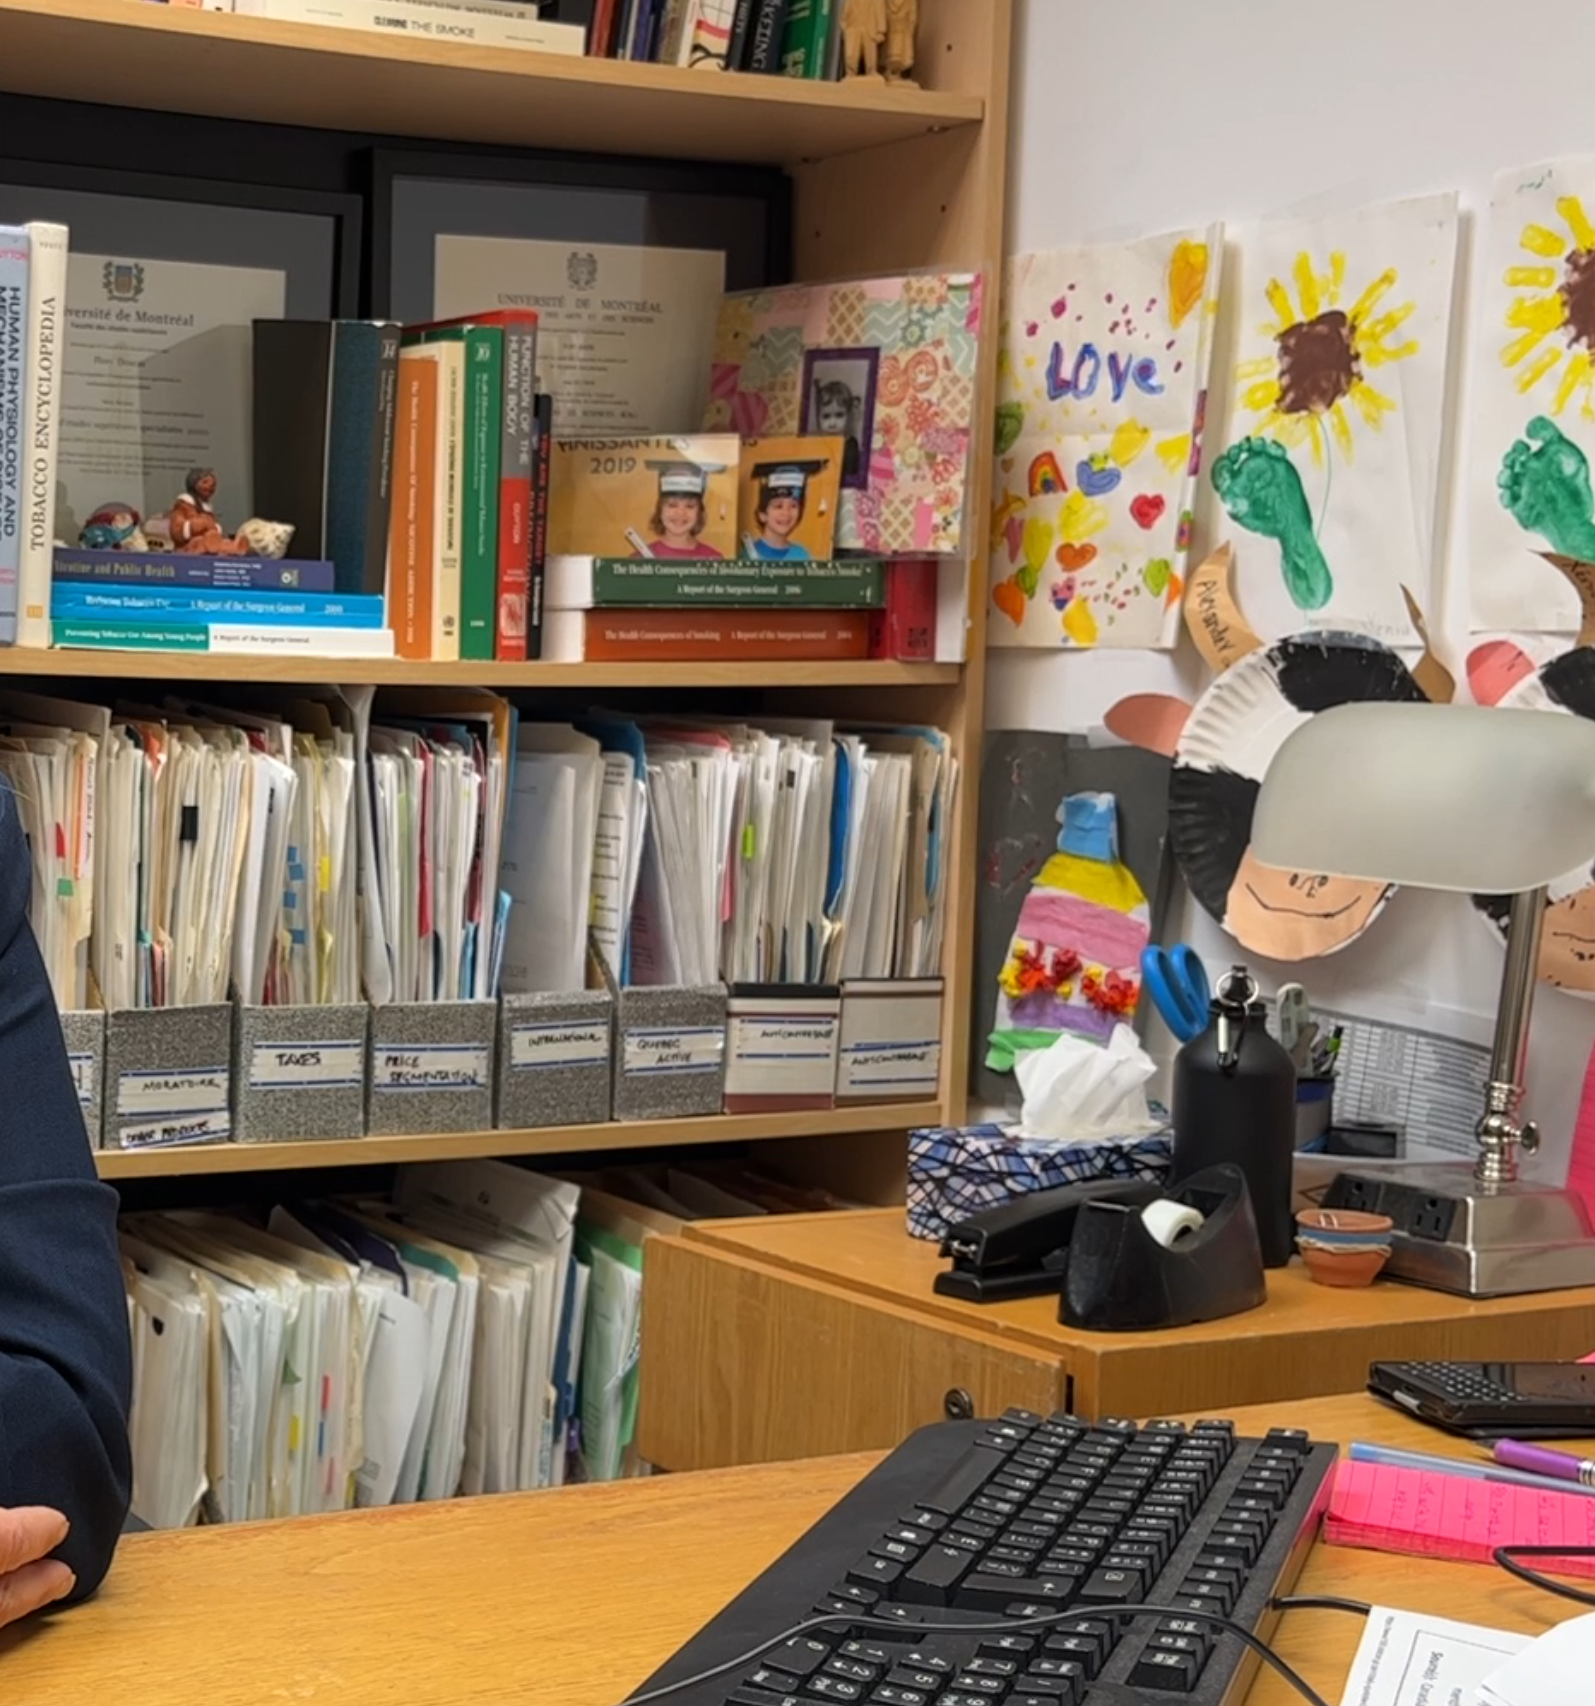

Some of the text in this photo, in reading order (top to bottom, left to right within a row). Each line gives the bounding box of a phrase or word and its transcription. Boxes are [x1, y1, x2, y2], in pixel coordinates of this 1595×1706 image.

[411, 20, 432, 34] THE
[436, 22, 477, 39] SMOKE
[498, 293, 663, 314] UNIVERSITÉ DE MONTRÉAL
[115, 309, 132, 322] de
[134, 310, 194, 327] Montréal
[507, 336, 518, 435] HUMAN BODY
[518, 336, 532, 465] FUNCTION OF THE
[3, 286, 21, 537] HUMAN PHYSIOLOGY AND
[30, 296, 56, 552] TOBACCO ENCYCLOPEDIA
[539, 435, 549, 458] YOU
[538, 463, 547, 486] ARE
[589, 457, 637, 474] 2019
[537, 491, 546, 514] THE
[612, 563, 627, 574] The
[628, 563, 653, 575] Health
[655, 564, 707, 578] Consequences
[683, 585, 704, 595] Report
[752, 585, 778, 595] General
[605, 630, 617, 640] The
[618, 630, 639, 640] Health
[639, 630, 685, 641] Consequences
[693, 630, 721, 642] Smoking
[737, 630, 759, 642] Report
[777, 630, 802, 642] Surgeon
[802, 631, 827, 640] General
[275, 1051, 321, 1067] TAXES
[385, 1055, 420, 1068] PRICE
[390, 1068, 478, 1085] SEGMENTATION
